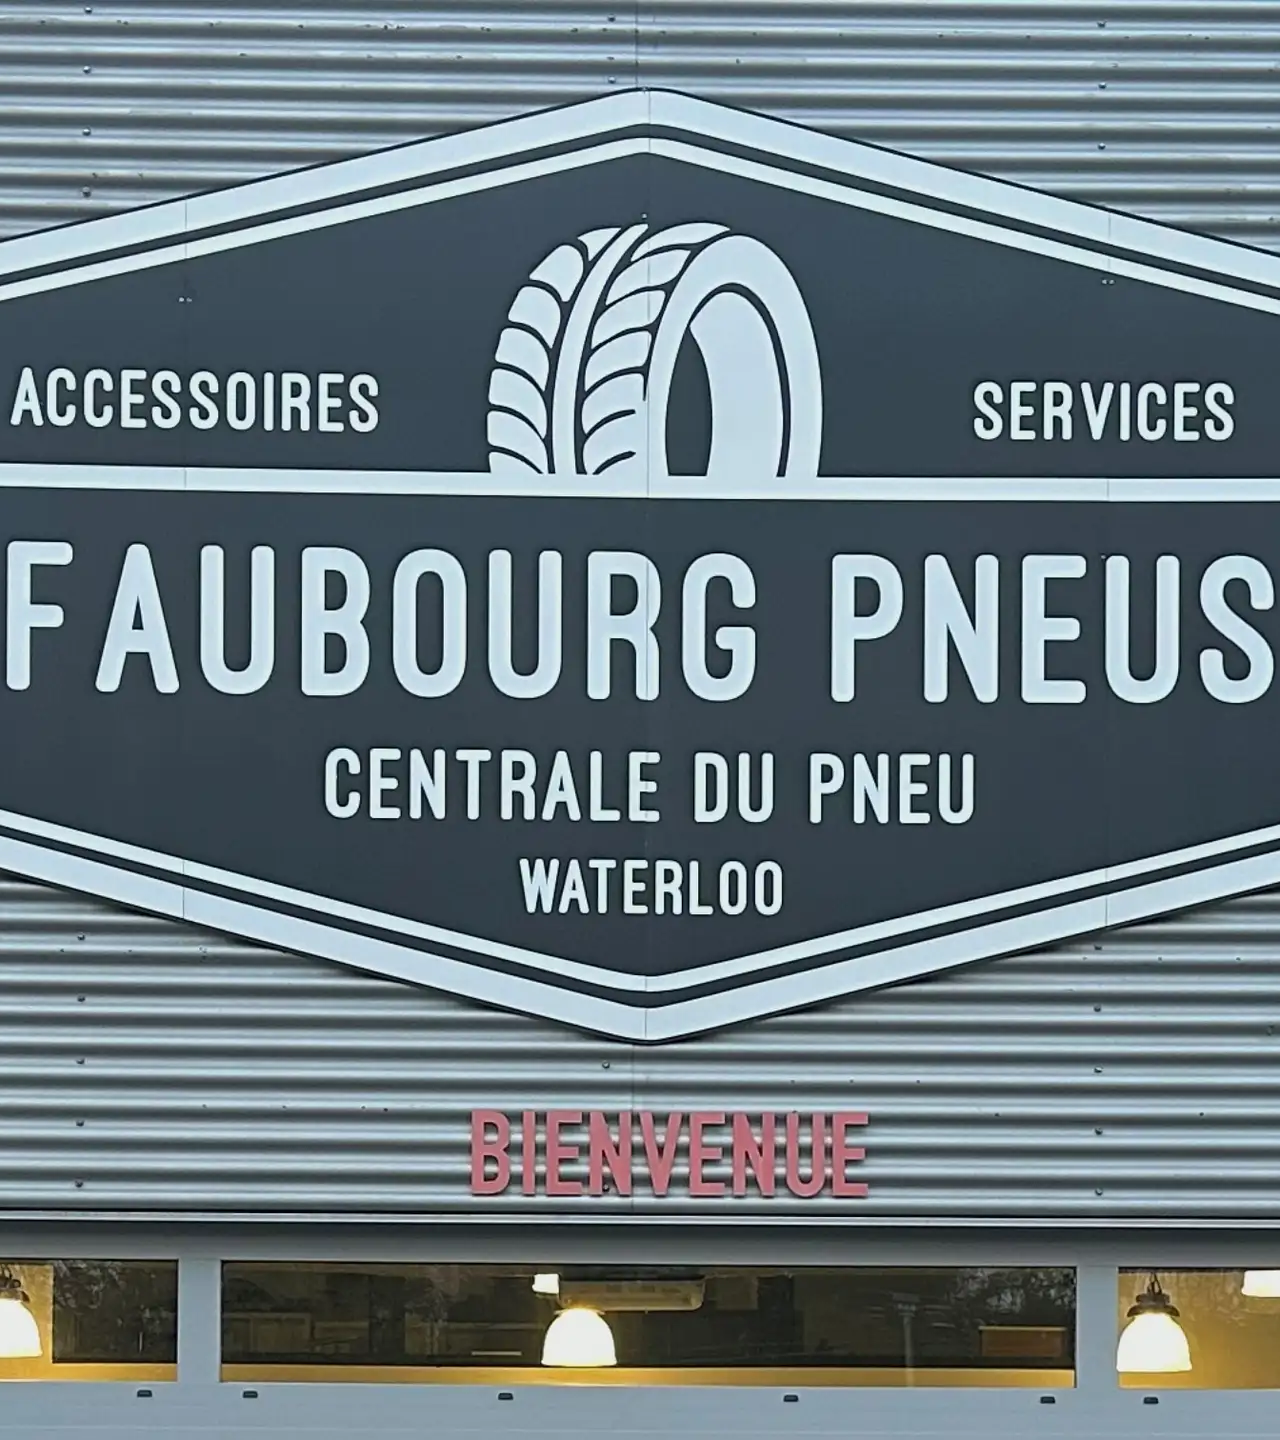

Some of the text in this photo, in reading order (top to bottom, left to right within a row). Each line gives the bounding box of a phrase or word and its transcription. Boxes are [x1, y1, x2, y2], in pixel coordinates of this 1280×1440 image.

[10, 367, 380, 434] ACCESSOIRES
[973, 381, 1236, 442] SERVICES
[6, 540, 1275, 704] FAUBOURG PNEUS
[324, 748, 975, 824] CENTRALE DU PNEU
[520, 858, 783, 915] WATERLOO
[470, 1110, 869, 1198] BIENVENUE
